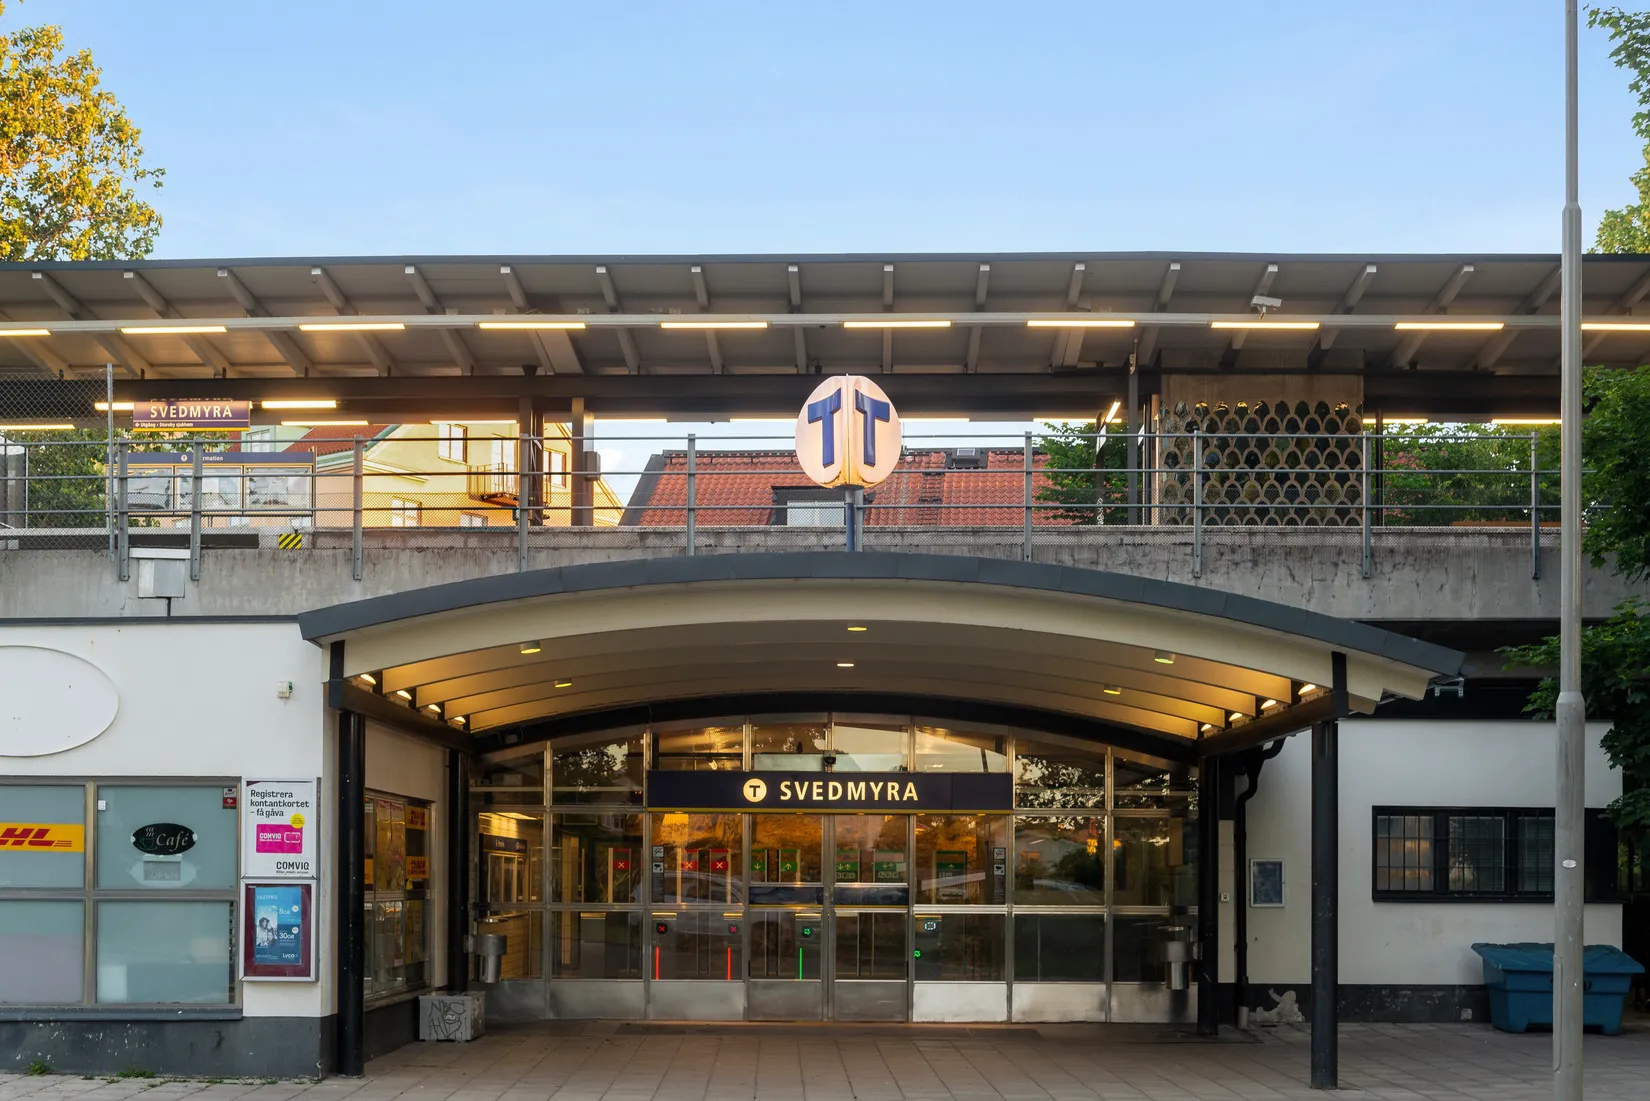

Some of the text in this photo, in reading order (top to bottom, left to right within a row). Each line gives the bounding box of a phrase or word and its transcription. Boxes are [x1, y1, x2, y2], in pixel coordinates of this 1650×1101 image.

[150, 405, 233, 418] SVEDMYRA
[808, 387, 842, 468] T
[855, 388, 891, 468] T
[250, 789, 293, 800] Registrera
[780, 781, 918, 800] SVEDMYRA
[250, 799, 310, 808] kontantkortet
[256, 808, 264, 817] få
[265, 808, 284, 818] gåva
[0, 828, 55, 847] HL
[156, 831, 190, 852] Café
[259, 832, 282, 840] COMVIQ
[276, 861, 310, 871] COMVIQ
